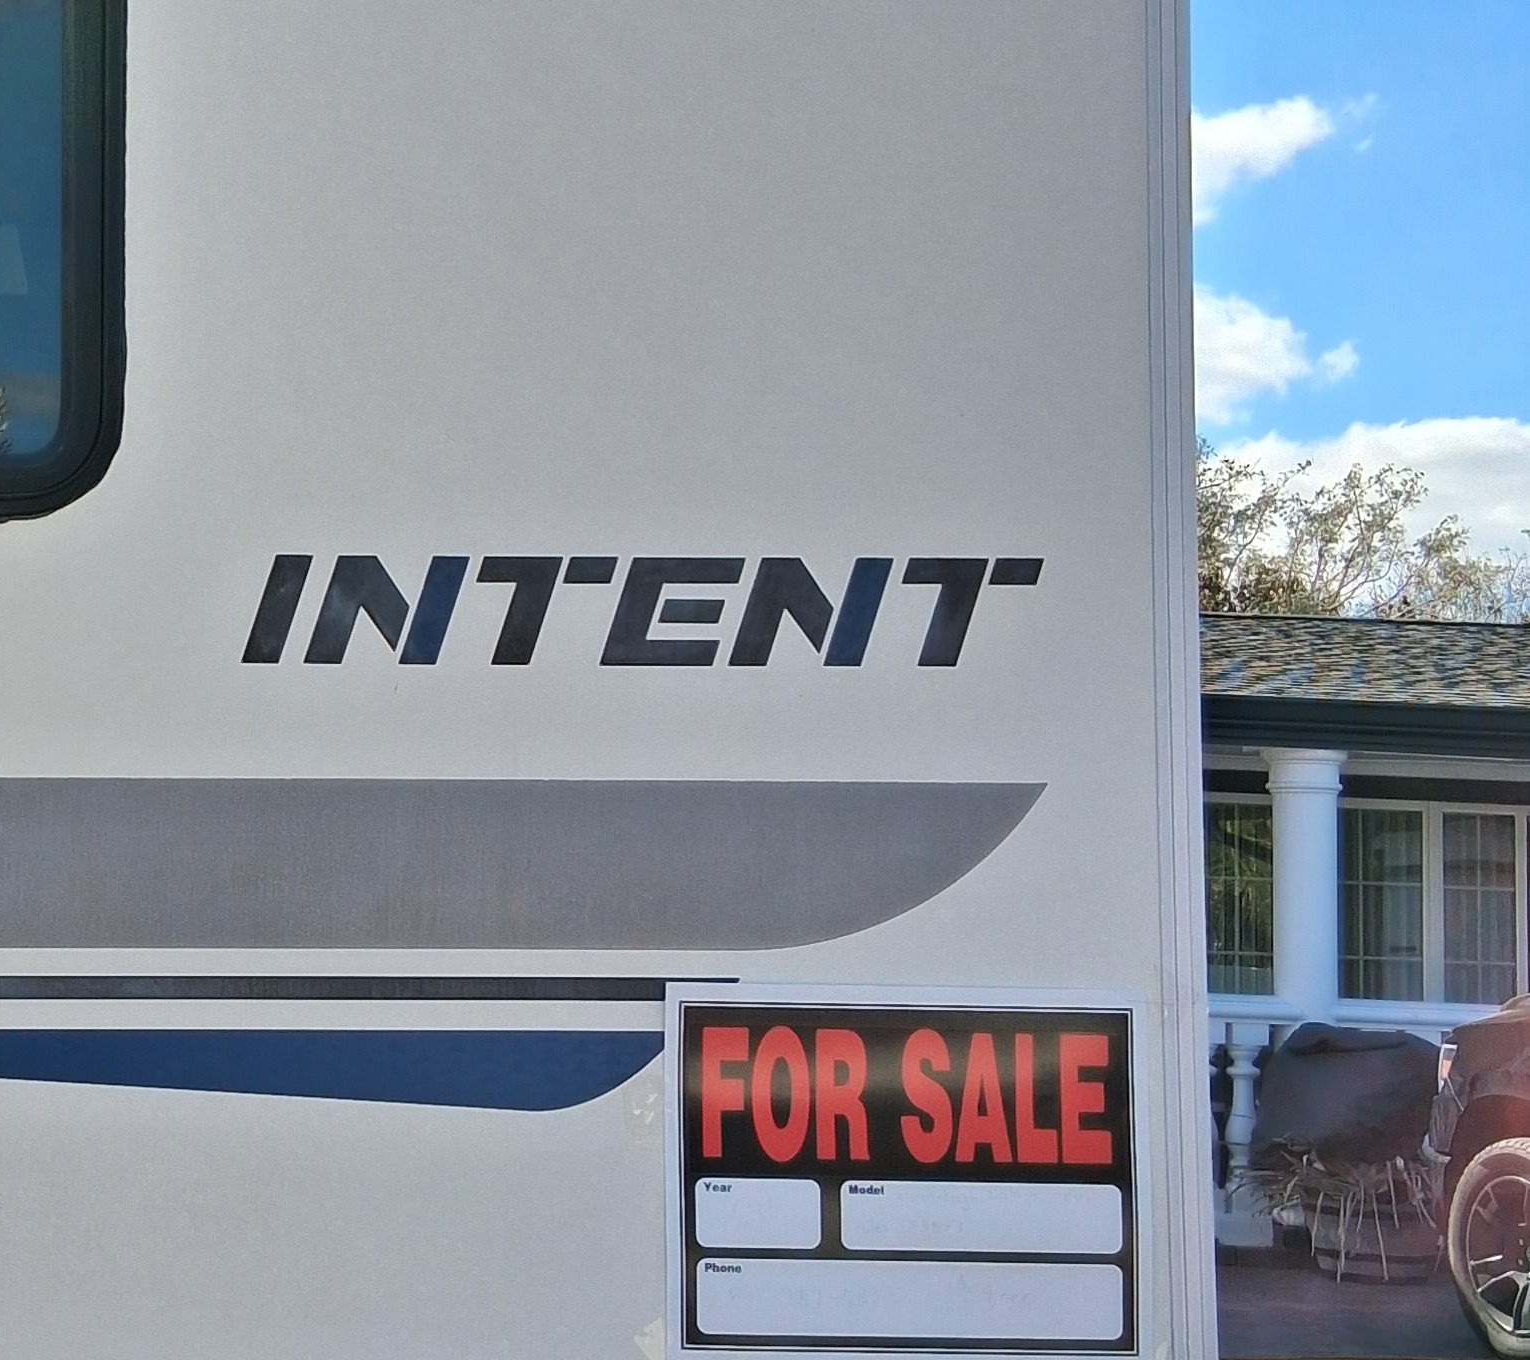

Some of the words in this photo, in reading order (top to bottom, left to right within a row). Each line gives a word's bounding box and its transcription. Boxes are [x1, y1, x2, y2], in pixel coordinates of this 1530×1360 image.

[241, 553, 1045, 667] INTENT
[701, 1025, 870, 1163] FOR
[899, 1028, 1113, 1165] SALE
[703, 1182, 733, 1194] Year
[847, 1184, 885, 1196] Model
[703, 1262, 743, 1275] Phone
